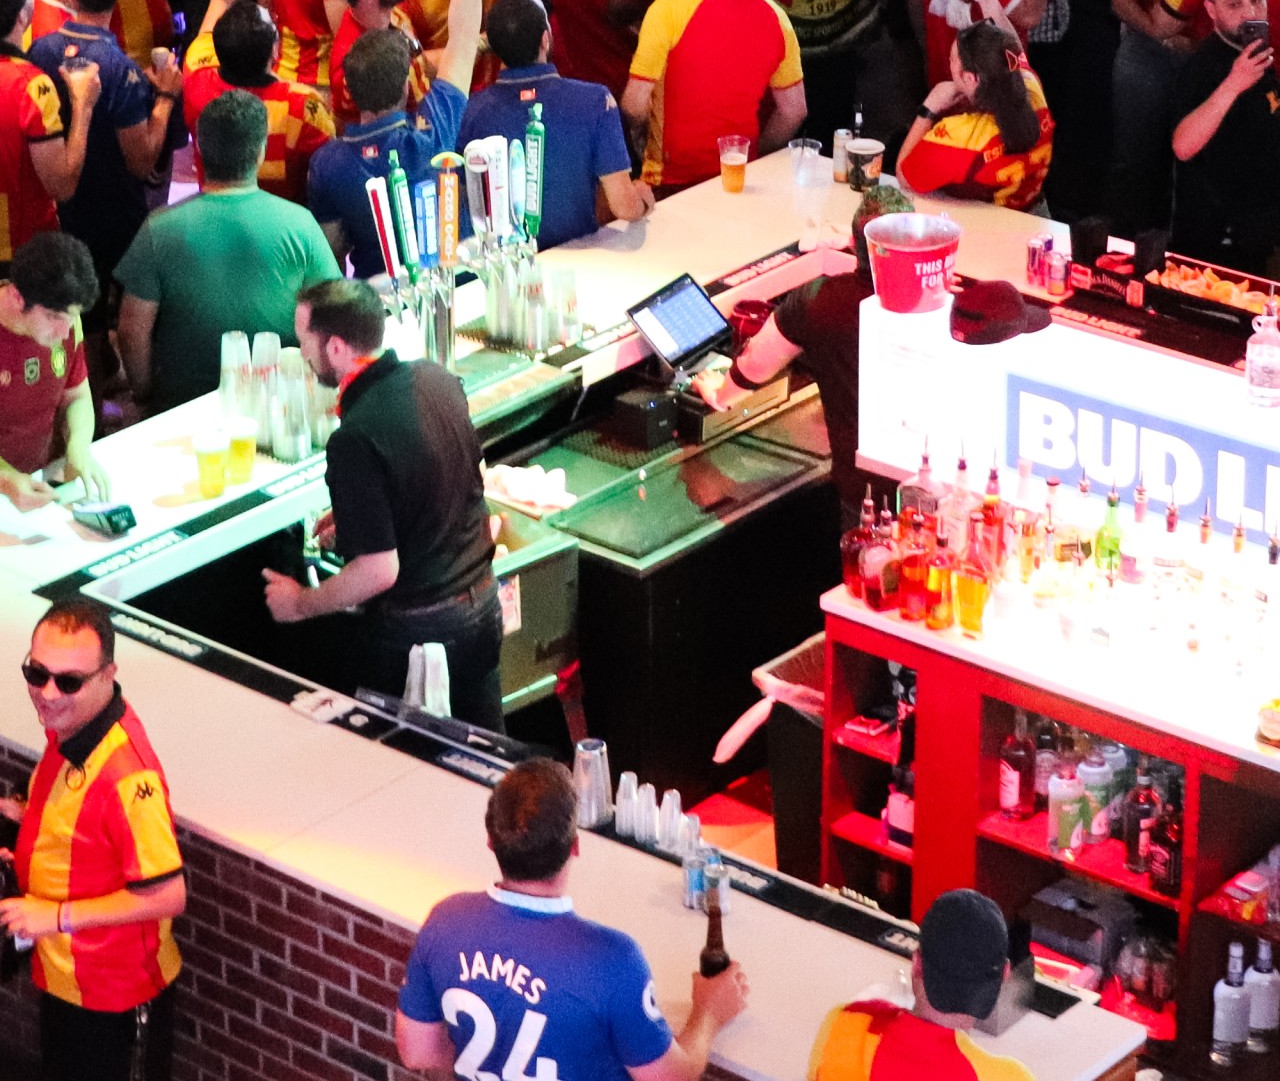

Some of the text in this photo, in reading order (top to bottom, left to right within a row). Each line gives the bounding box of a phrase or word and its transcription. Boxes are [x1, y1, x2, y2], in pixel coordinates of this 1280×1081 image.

[914, 259, 942, 276] THIS
[921, 273, 944, 288] FOR
[1019, 390, 1203, 508] BUD
[459, 950, 547, 1005] JAMES
[440, 987, 565, 1081] 24
